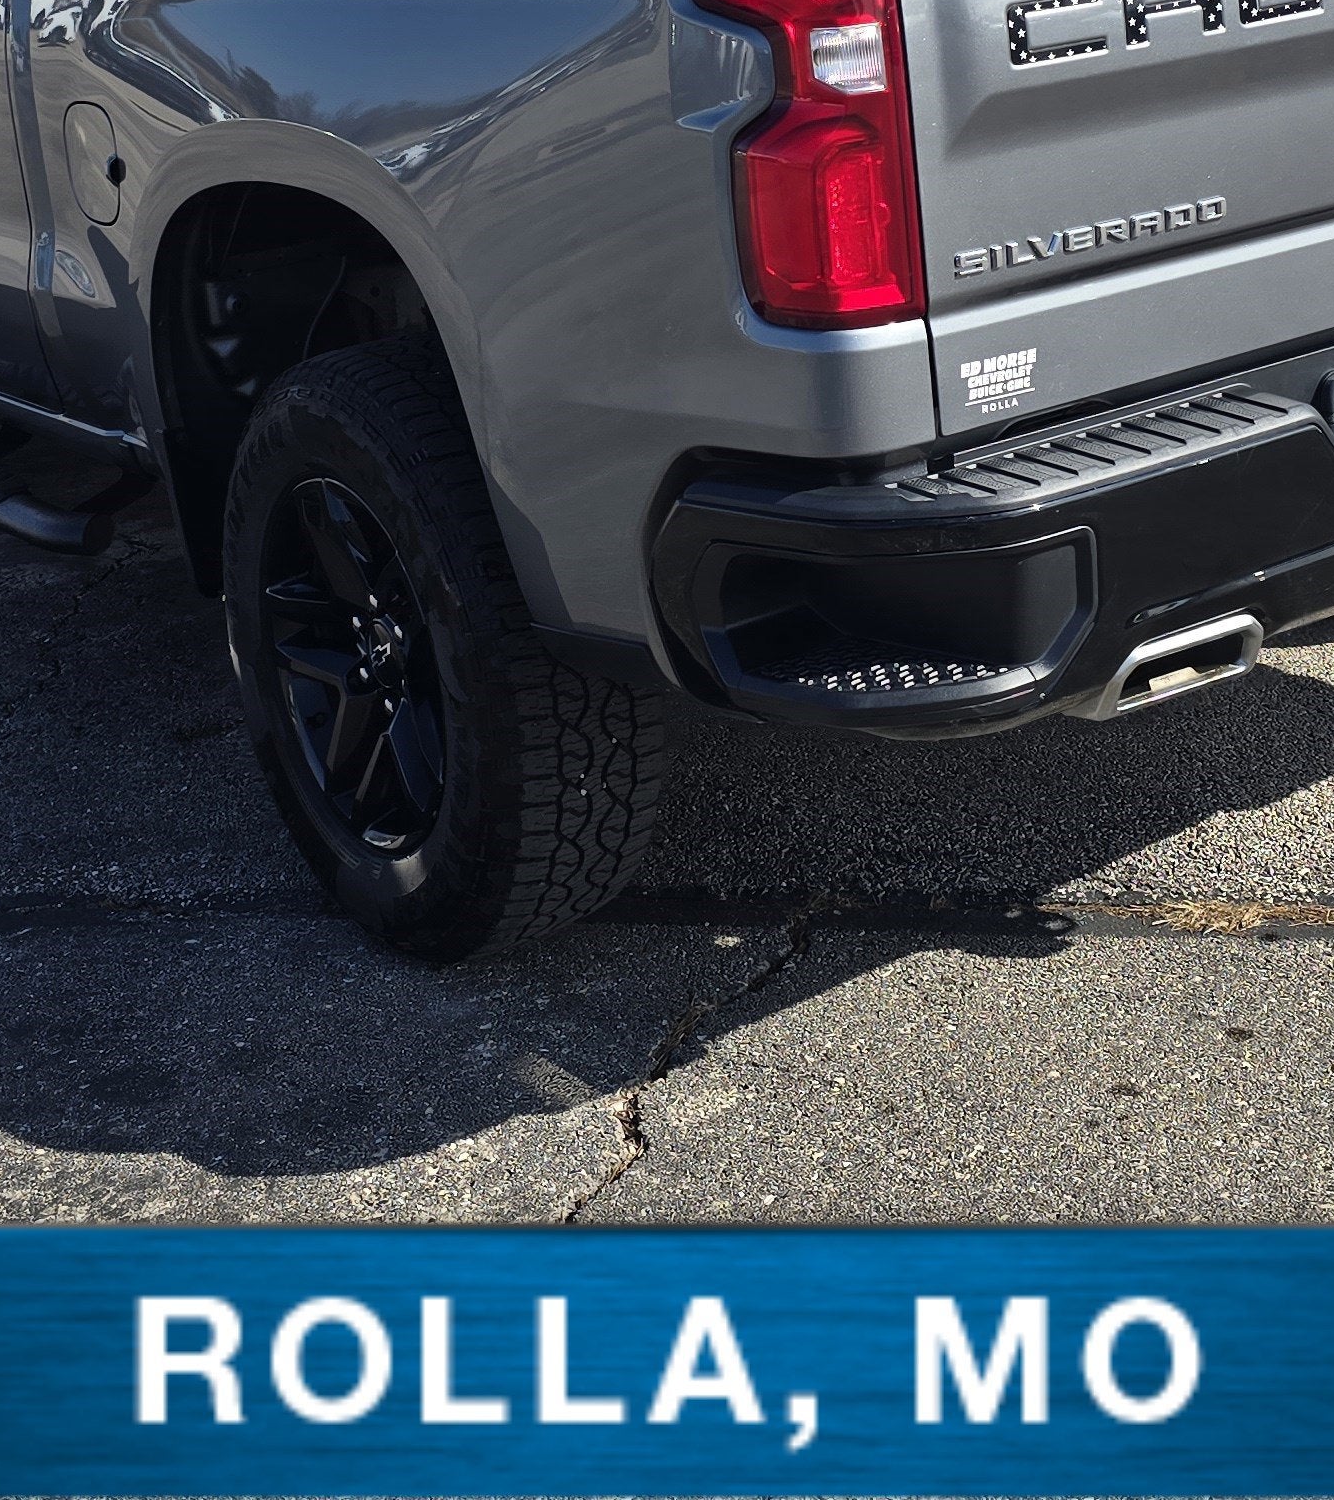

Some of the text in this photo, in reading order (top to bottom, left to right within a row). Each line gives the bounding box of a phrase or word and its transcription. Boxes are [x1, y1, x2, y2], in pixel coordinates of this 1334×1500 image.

[953, 195, 1228, 279] SILVERADO
[960, 348, 1037, 379] ED MORSE
[968, 364, 1034, 389] CHEVROLET
[982, 397, 1019, 414] ROLLA
